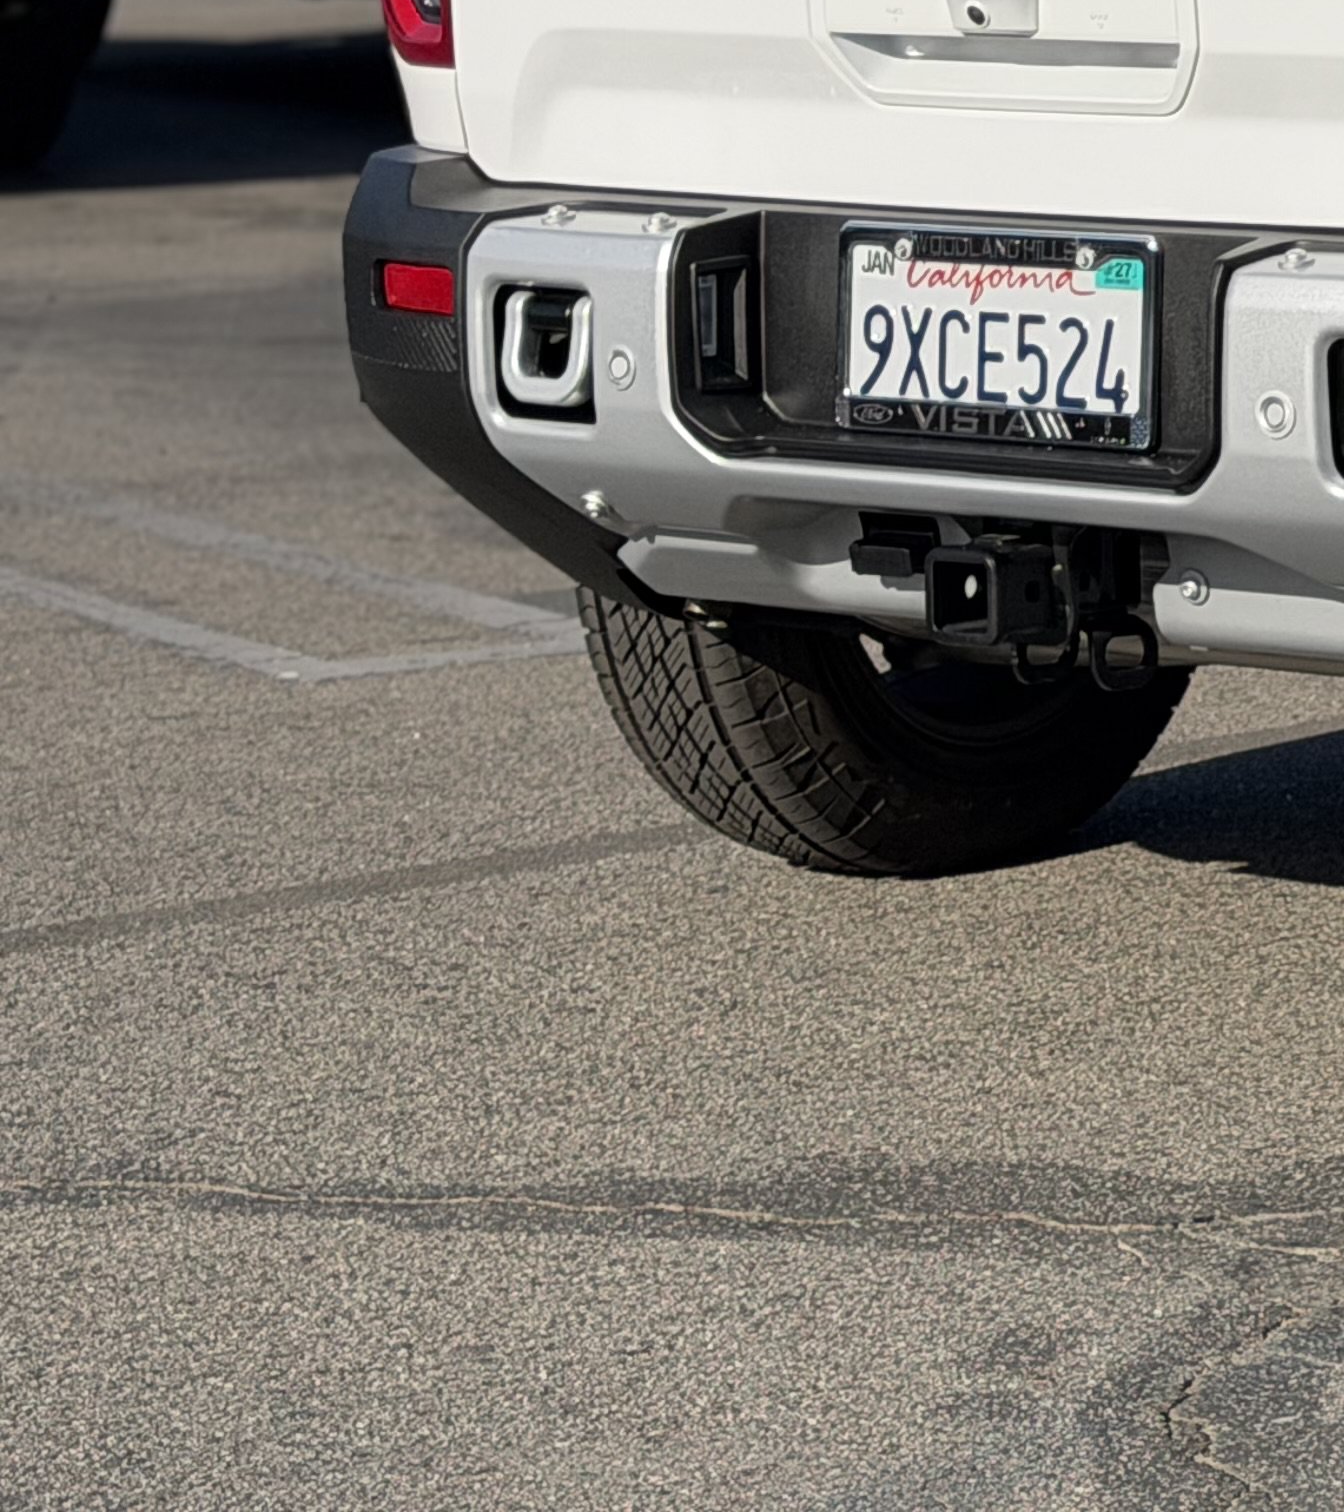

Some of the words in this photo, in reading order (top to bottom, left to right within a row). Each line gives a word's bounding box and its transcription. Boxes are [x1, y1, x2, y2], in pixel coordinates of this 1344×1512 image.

[861, 249, 895, 276] JAN
[912, 233, 1020, 259] WOODLAND
[1024, 238, 1077, 262] HILLS
[906, 257, 1096, 305] California
[1114, 262, 1132, 278] 27
[860, 303, 1127, 414] 9XCE524
[911, 404, 1036, 438] VISTA
